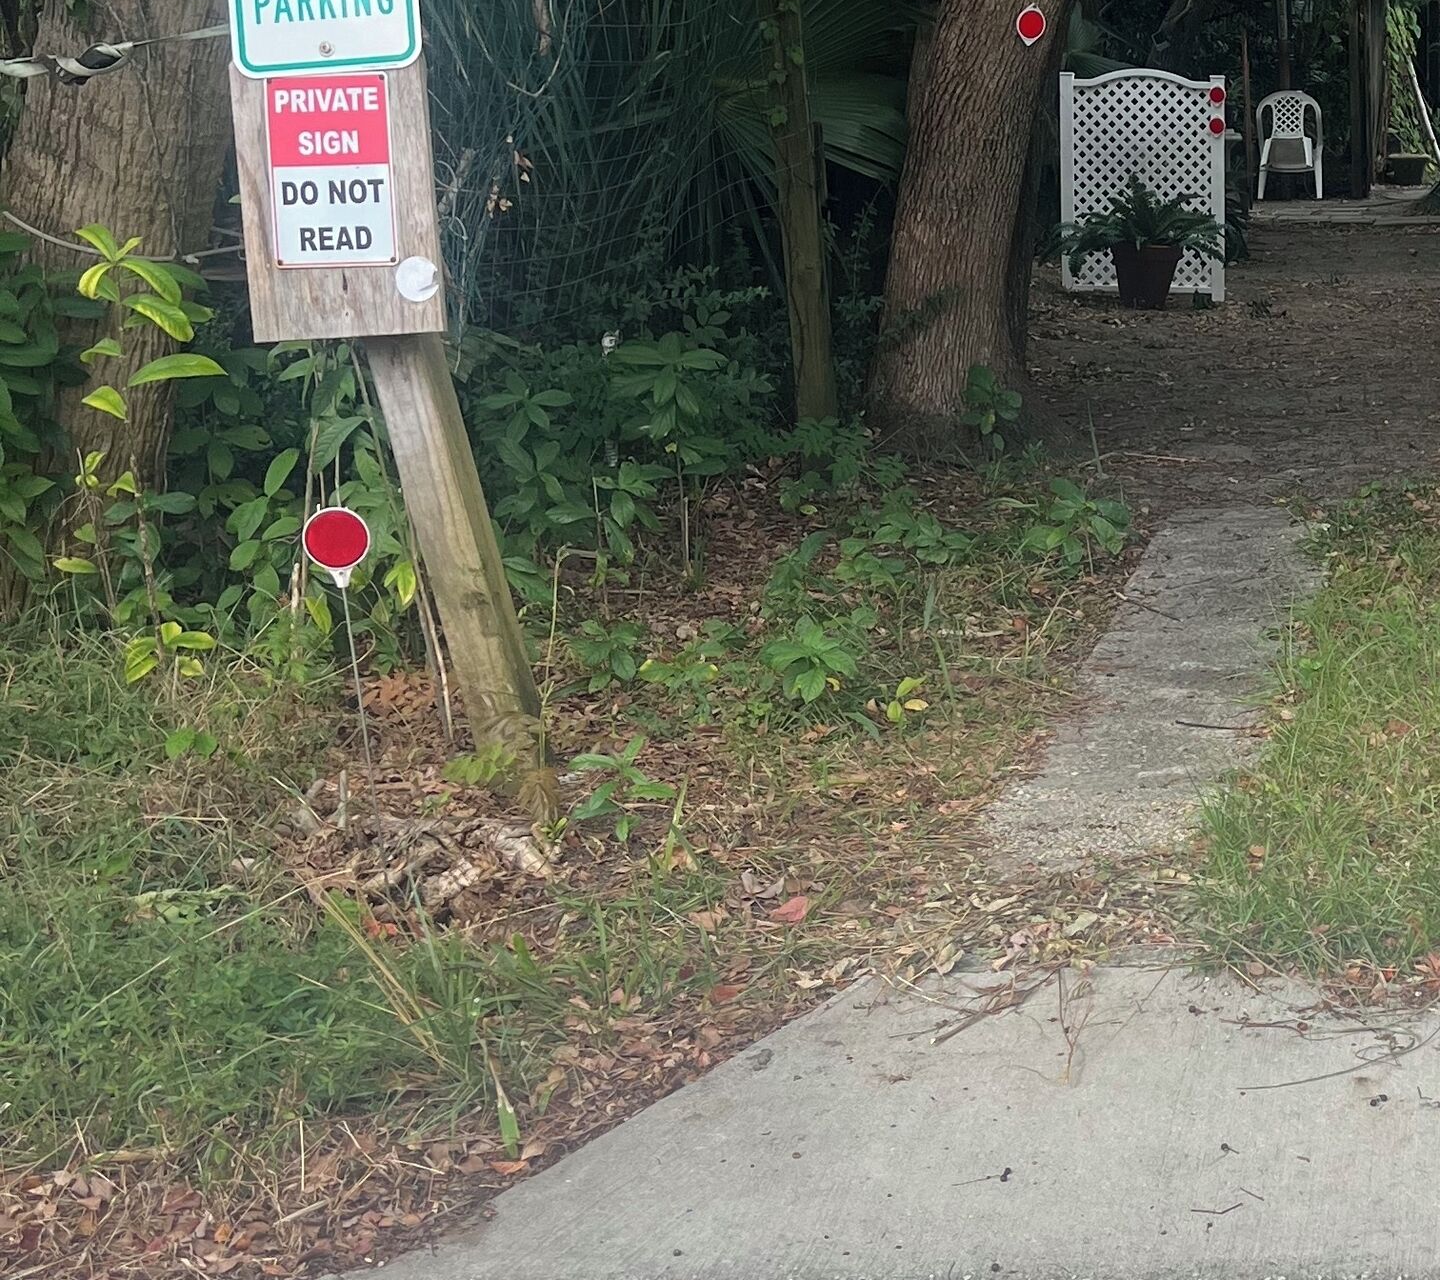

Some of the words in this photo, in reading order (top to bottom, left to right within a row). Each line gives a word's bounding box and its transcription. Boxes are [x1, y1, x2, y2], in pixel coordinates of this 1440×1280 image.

[274, 86, 380, 114] PRIVATE
[297, 129, 360, 156] SIGN
[281, 180, 319, 206] DO
[328, 178, 385, 205] NOT
[299, 225, 373, 252] READ
